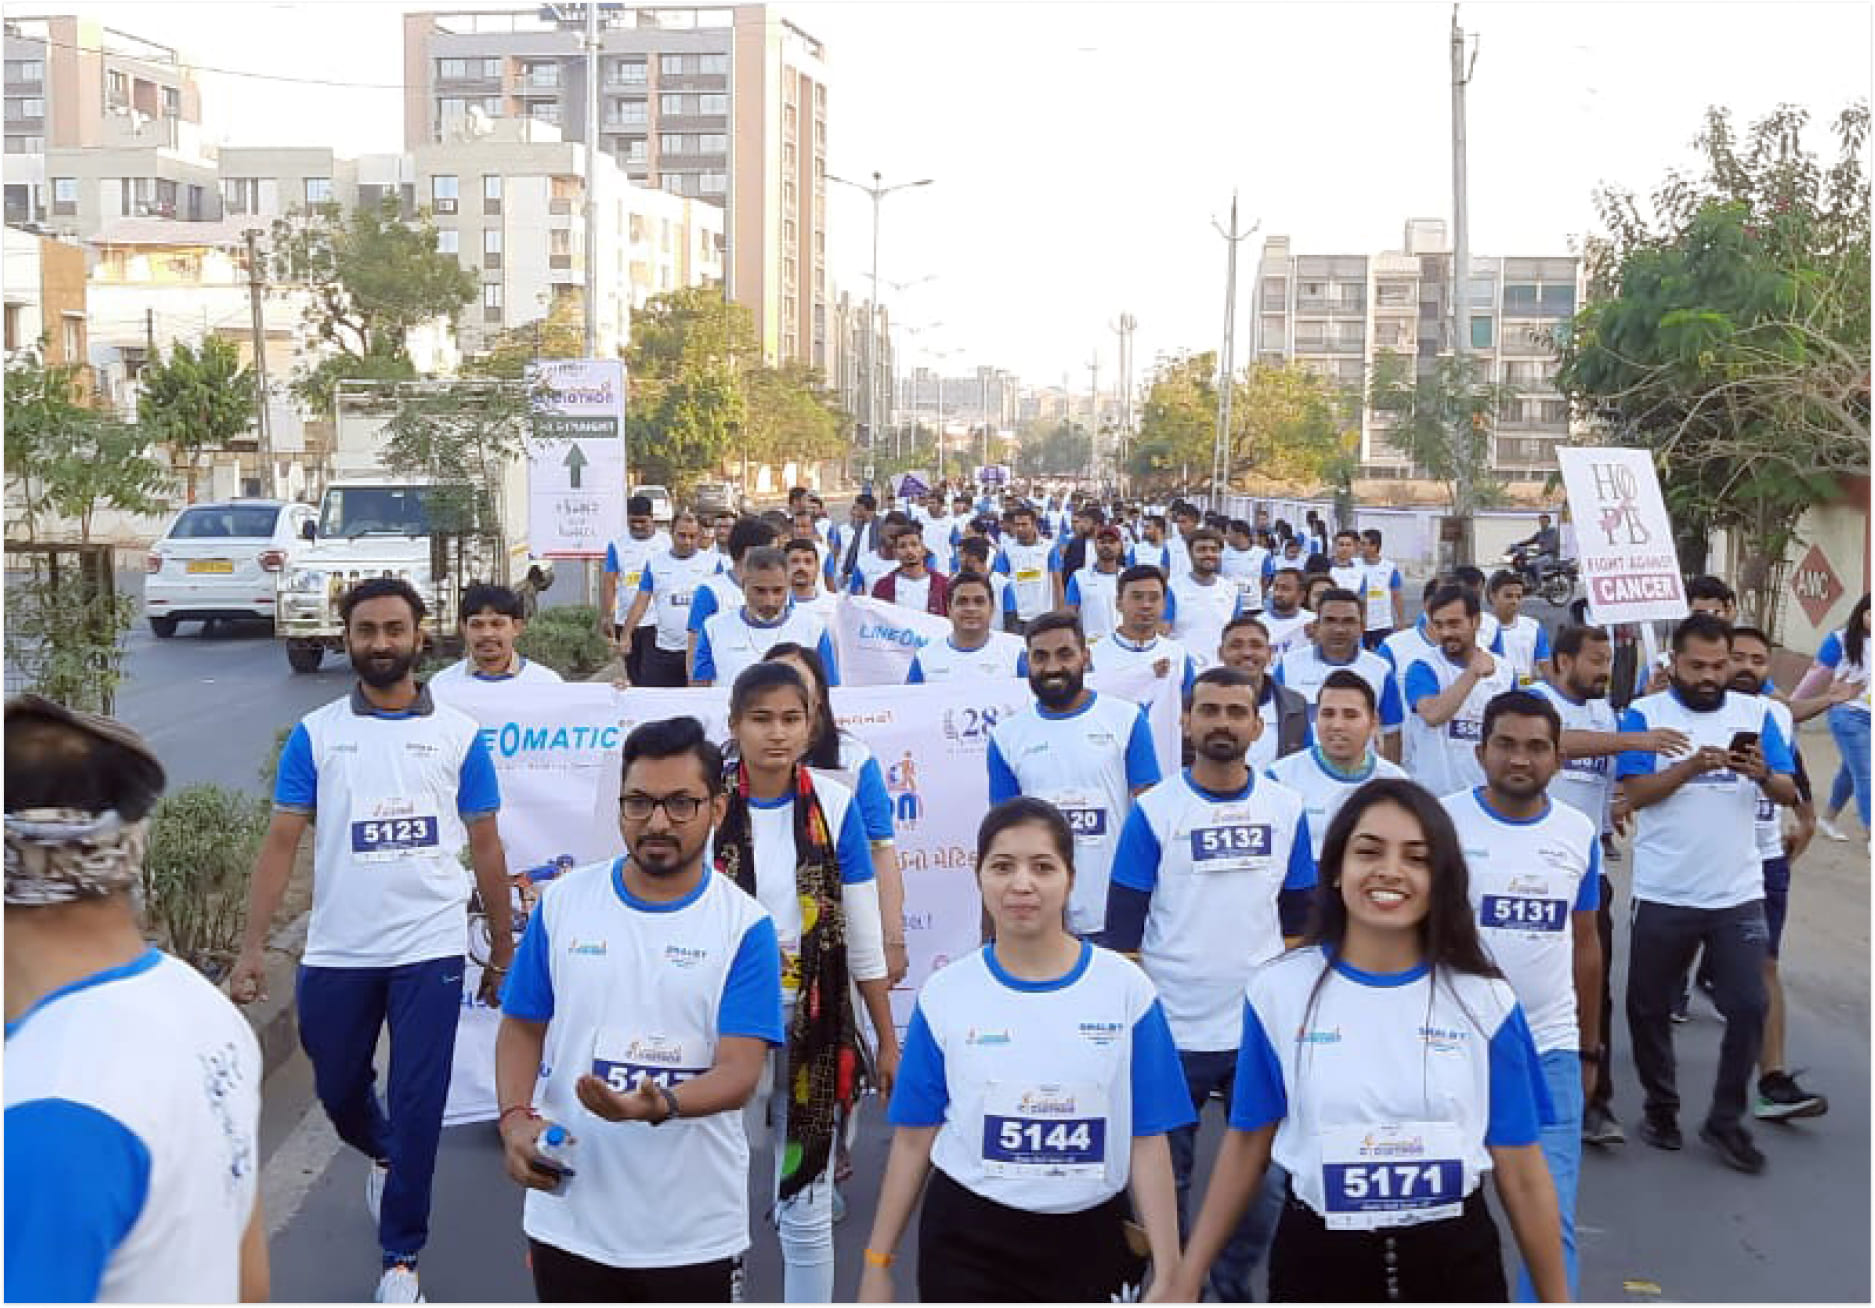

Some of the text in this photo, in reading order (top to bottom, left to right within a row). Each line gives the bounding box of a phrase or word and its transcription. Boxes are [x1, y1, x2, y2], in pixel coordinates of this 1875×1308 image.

[1587, 557, 1624, 572] FIGHT
[1600, 578, 1673, 601] CANCER
[1797, 570, 1830, 600] AMC
[363, 819, 428, 843] 5123
[1202, 825, 1265, 850] 5132
[1493, 899, 1556, 921] 5131
[999, 1121, 1092, 1151] 5144
[1343, 1164, 1443, 1198] 5171
